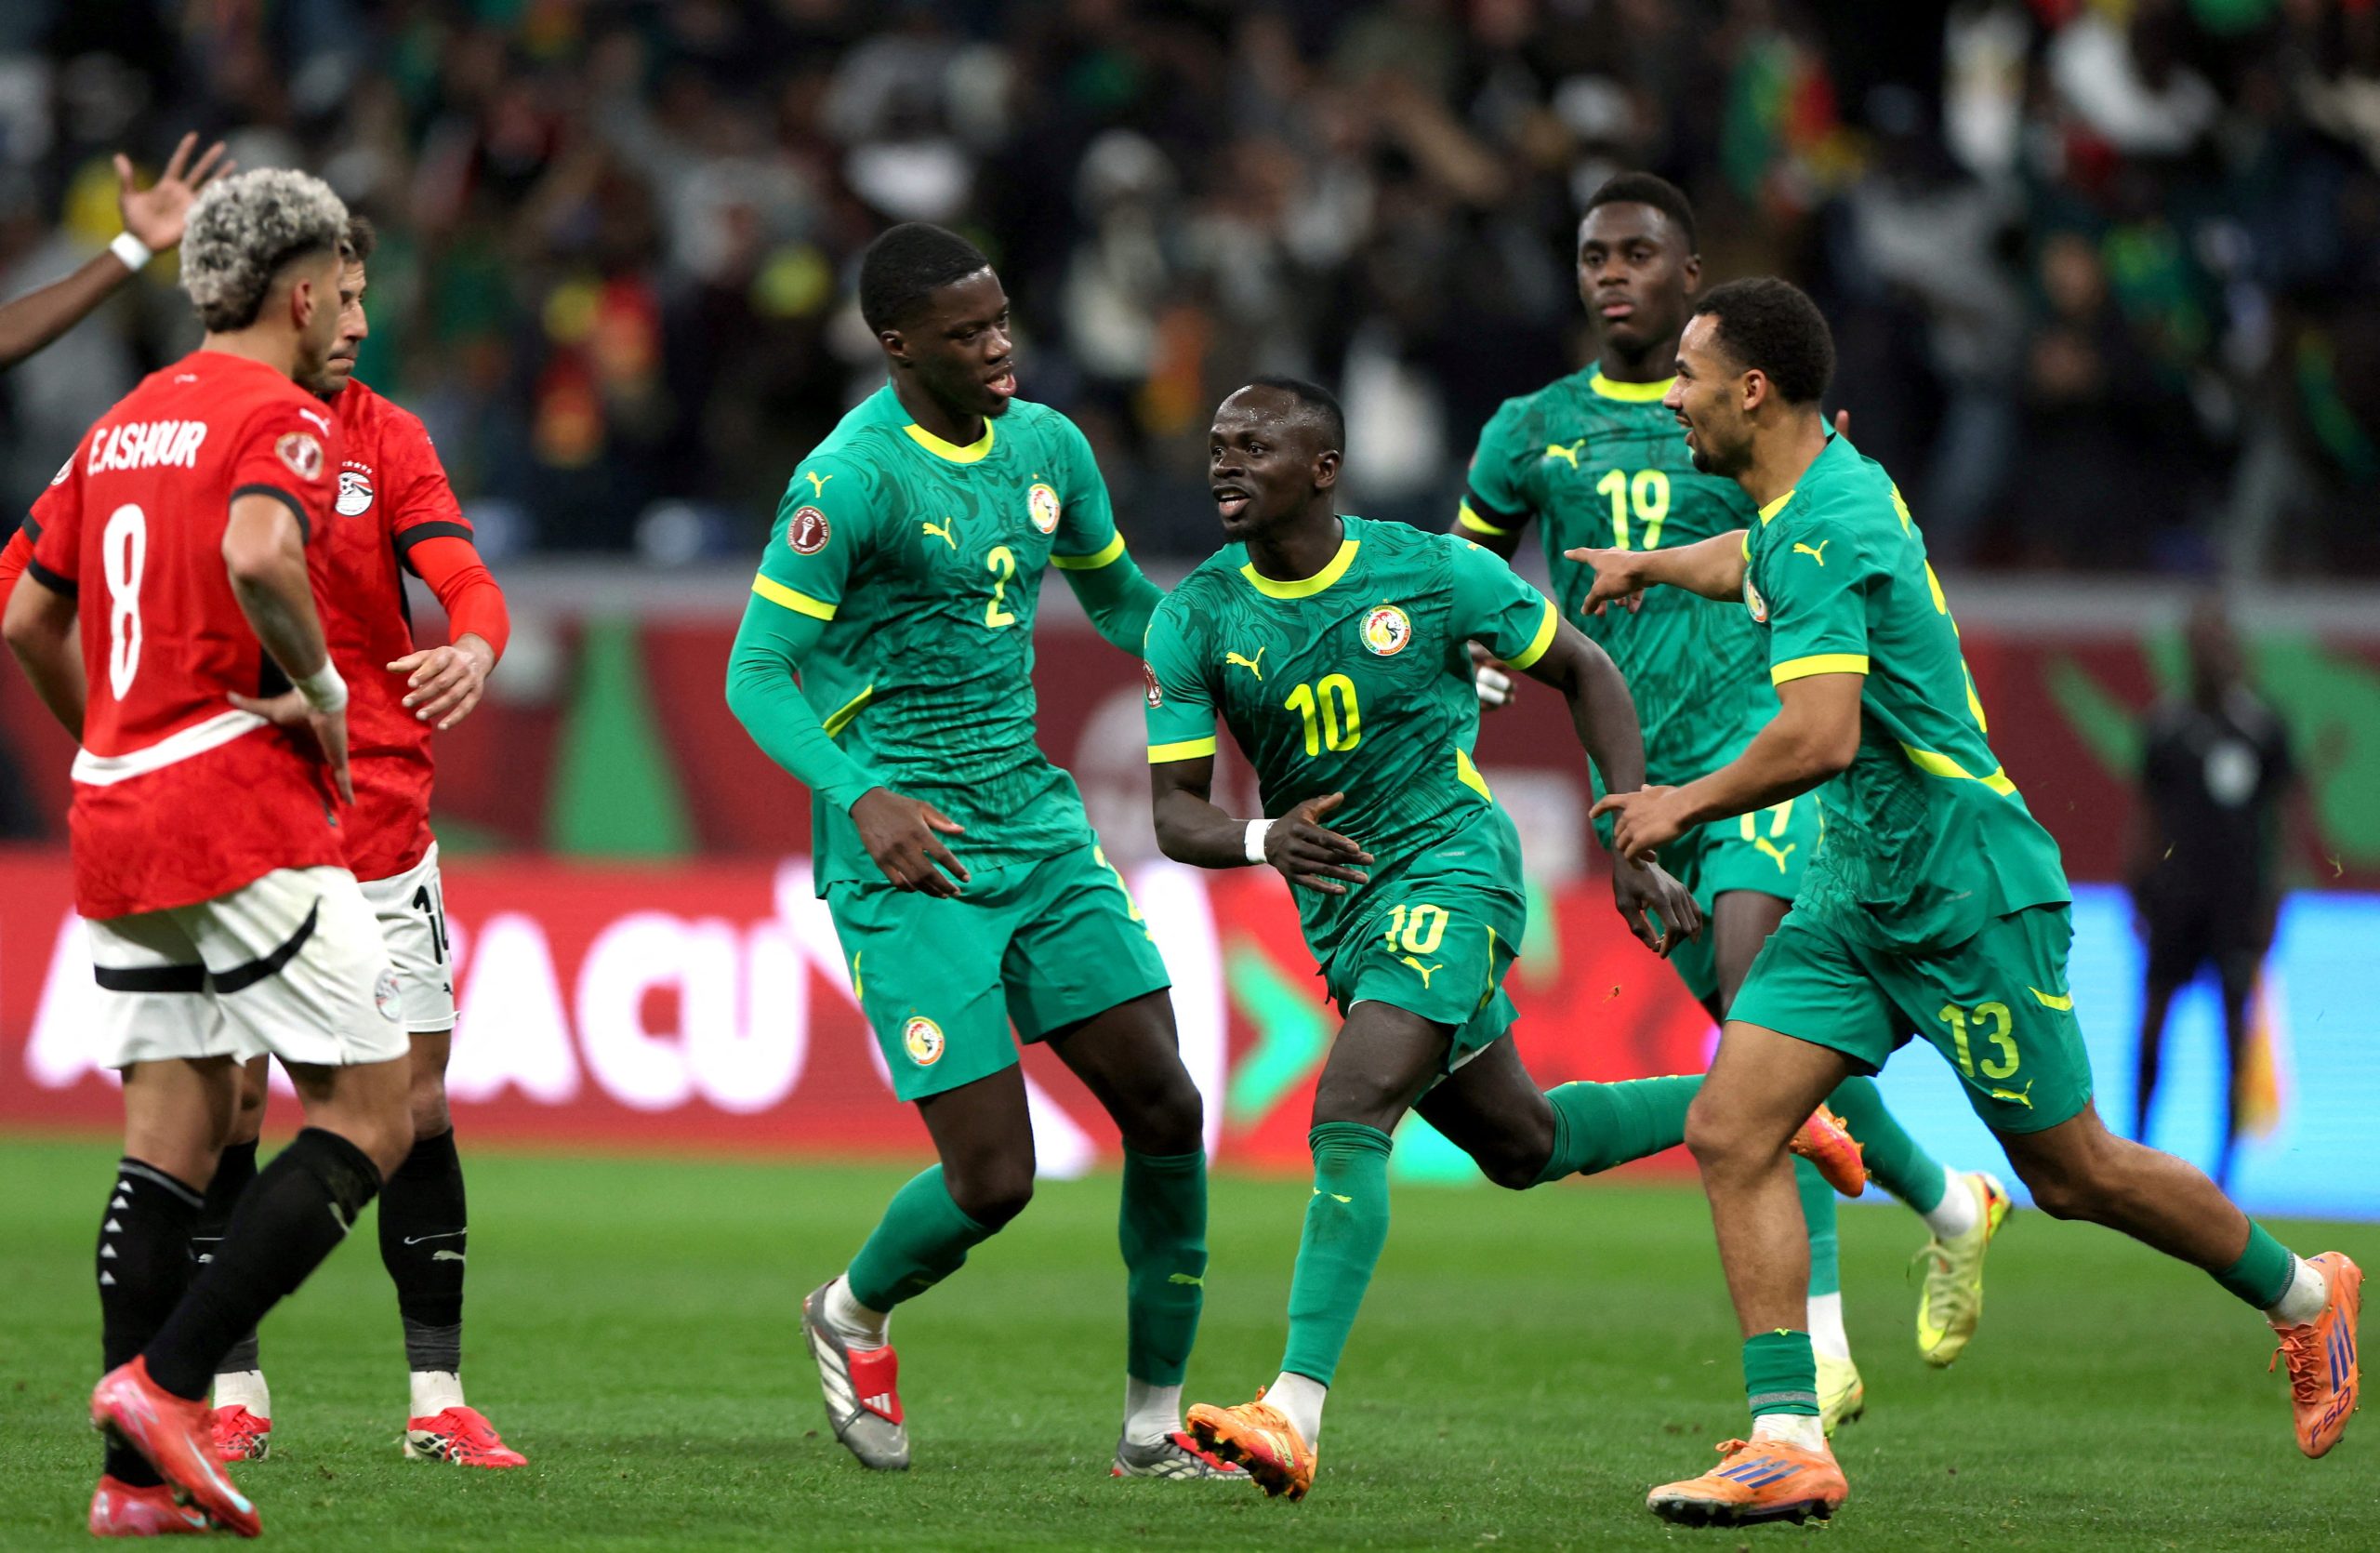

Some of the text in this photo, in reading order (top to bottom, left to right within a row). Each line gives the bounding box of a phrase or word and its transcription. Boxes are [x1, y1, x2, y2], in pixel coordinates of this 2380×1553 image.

[1597, 468, 1671, 551] 19
[102, 503, 147, 703] 8
[985, 545, 1015, 629] 2
[1284, 673, 1361, 757] 10
[1384, 904, 1449, 954] 10
[1938, 1002, 2020, 1079] 13
